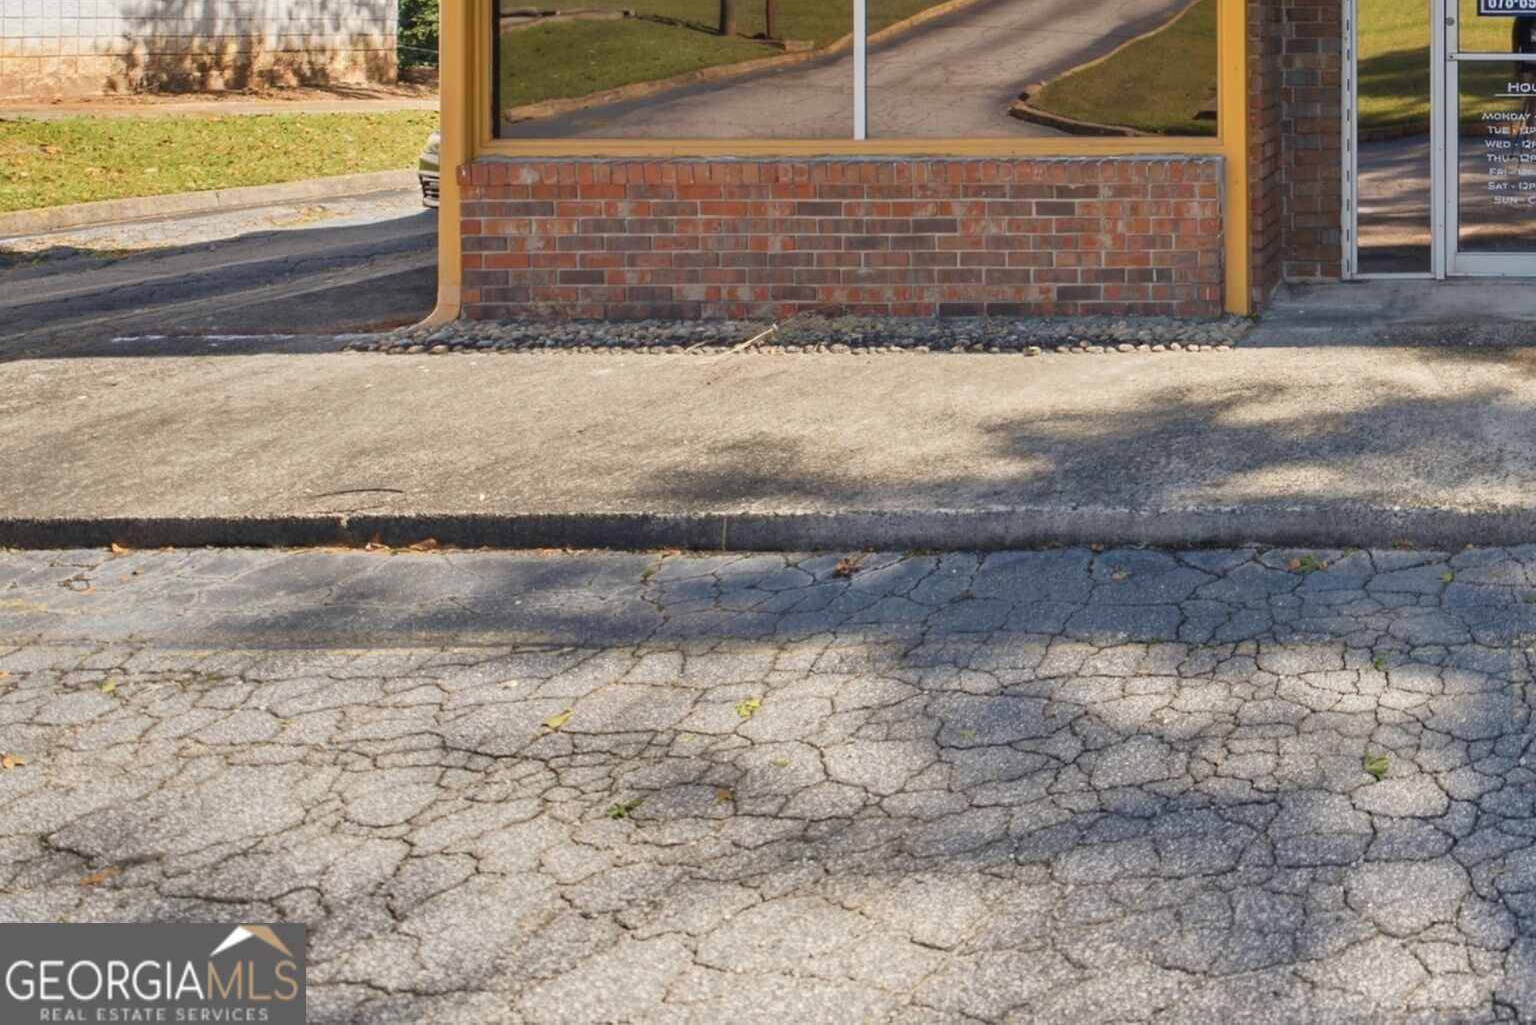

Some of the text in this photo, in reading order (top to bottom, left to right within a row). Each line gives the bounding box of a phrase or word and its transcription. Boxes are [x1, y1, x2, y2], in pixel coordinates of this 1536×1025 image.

[1481, 113, 1531, 121] MONDAY
[1487, 126, 1510, 135] TUE
[1485, 140, 1511, 149] WED
[1487, 154, 1509, 163] THU
[1488, 181, 1508, 190] SAT
